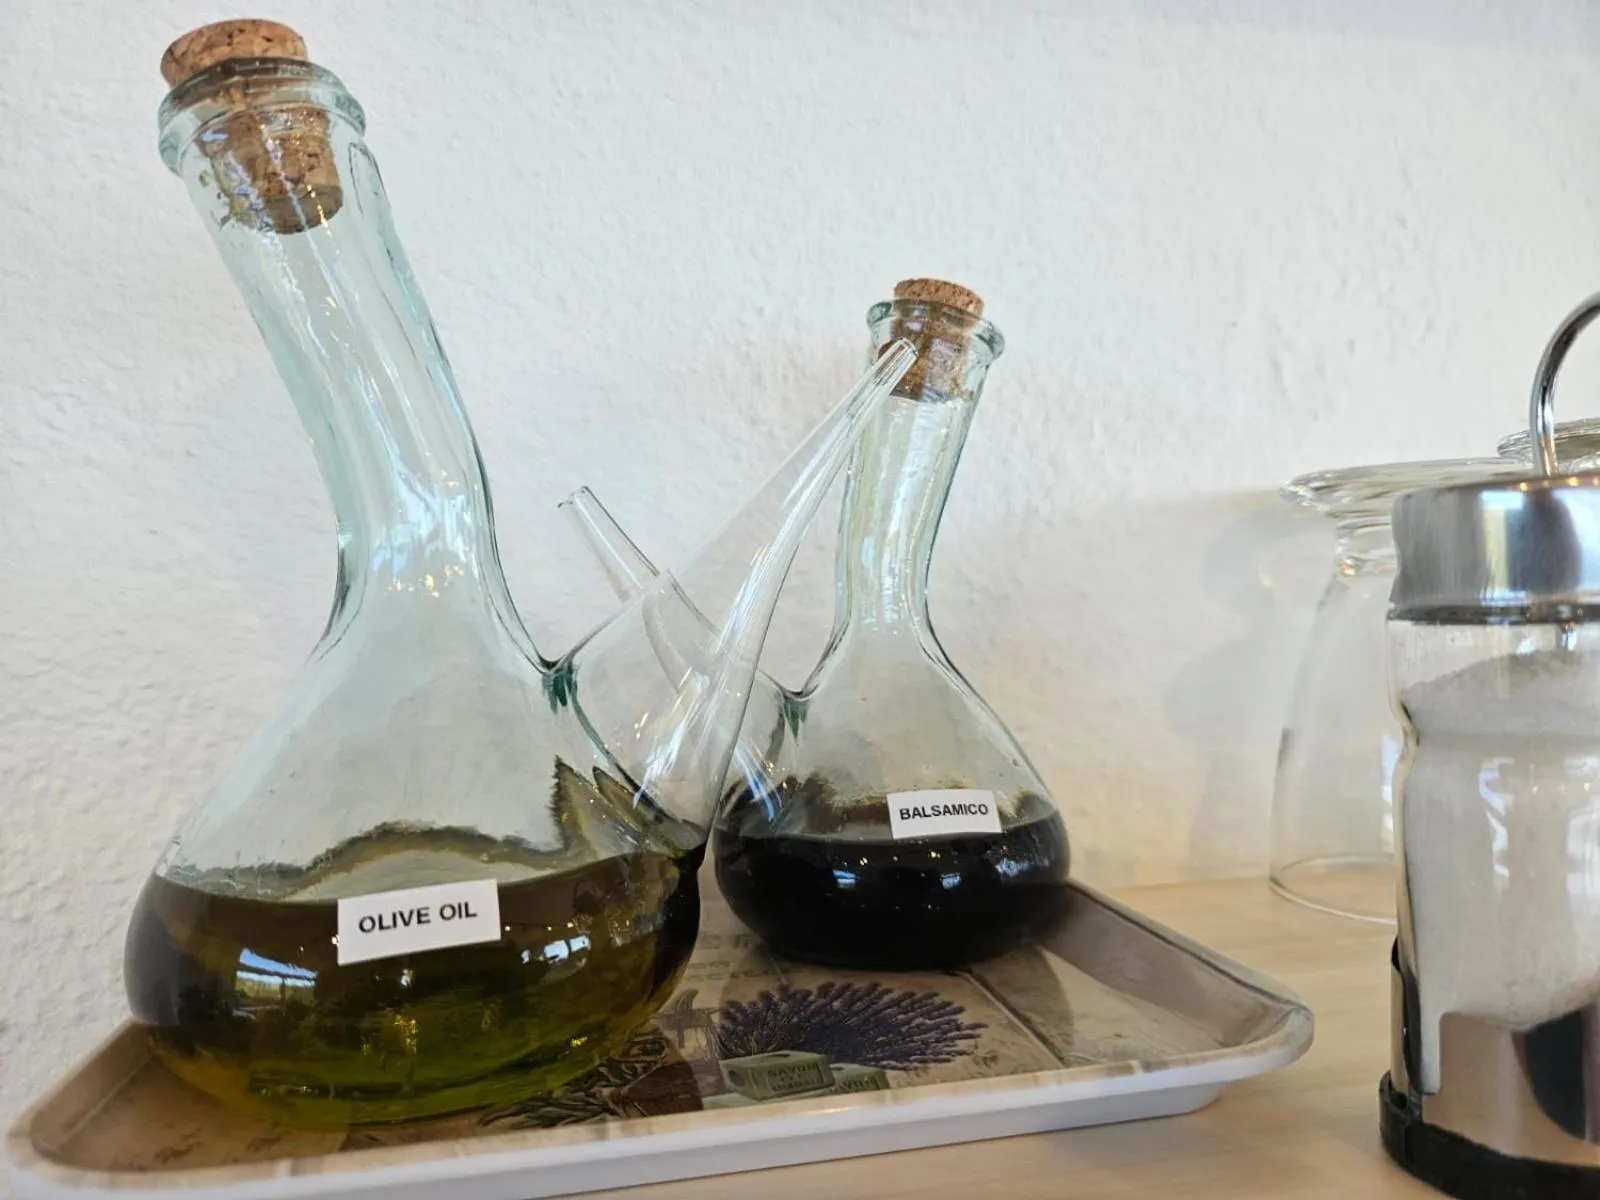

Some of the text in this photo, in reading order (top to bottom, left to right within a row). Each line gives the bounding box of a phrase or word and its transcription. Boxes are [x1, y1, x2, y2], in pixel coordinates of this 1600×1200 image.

[899, 803, 989, 820] BALSAMICO
[359, 901, 478, 933] OLIVE OIL
